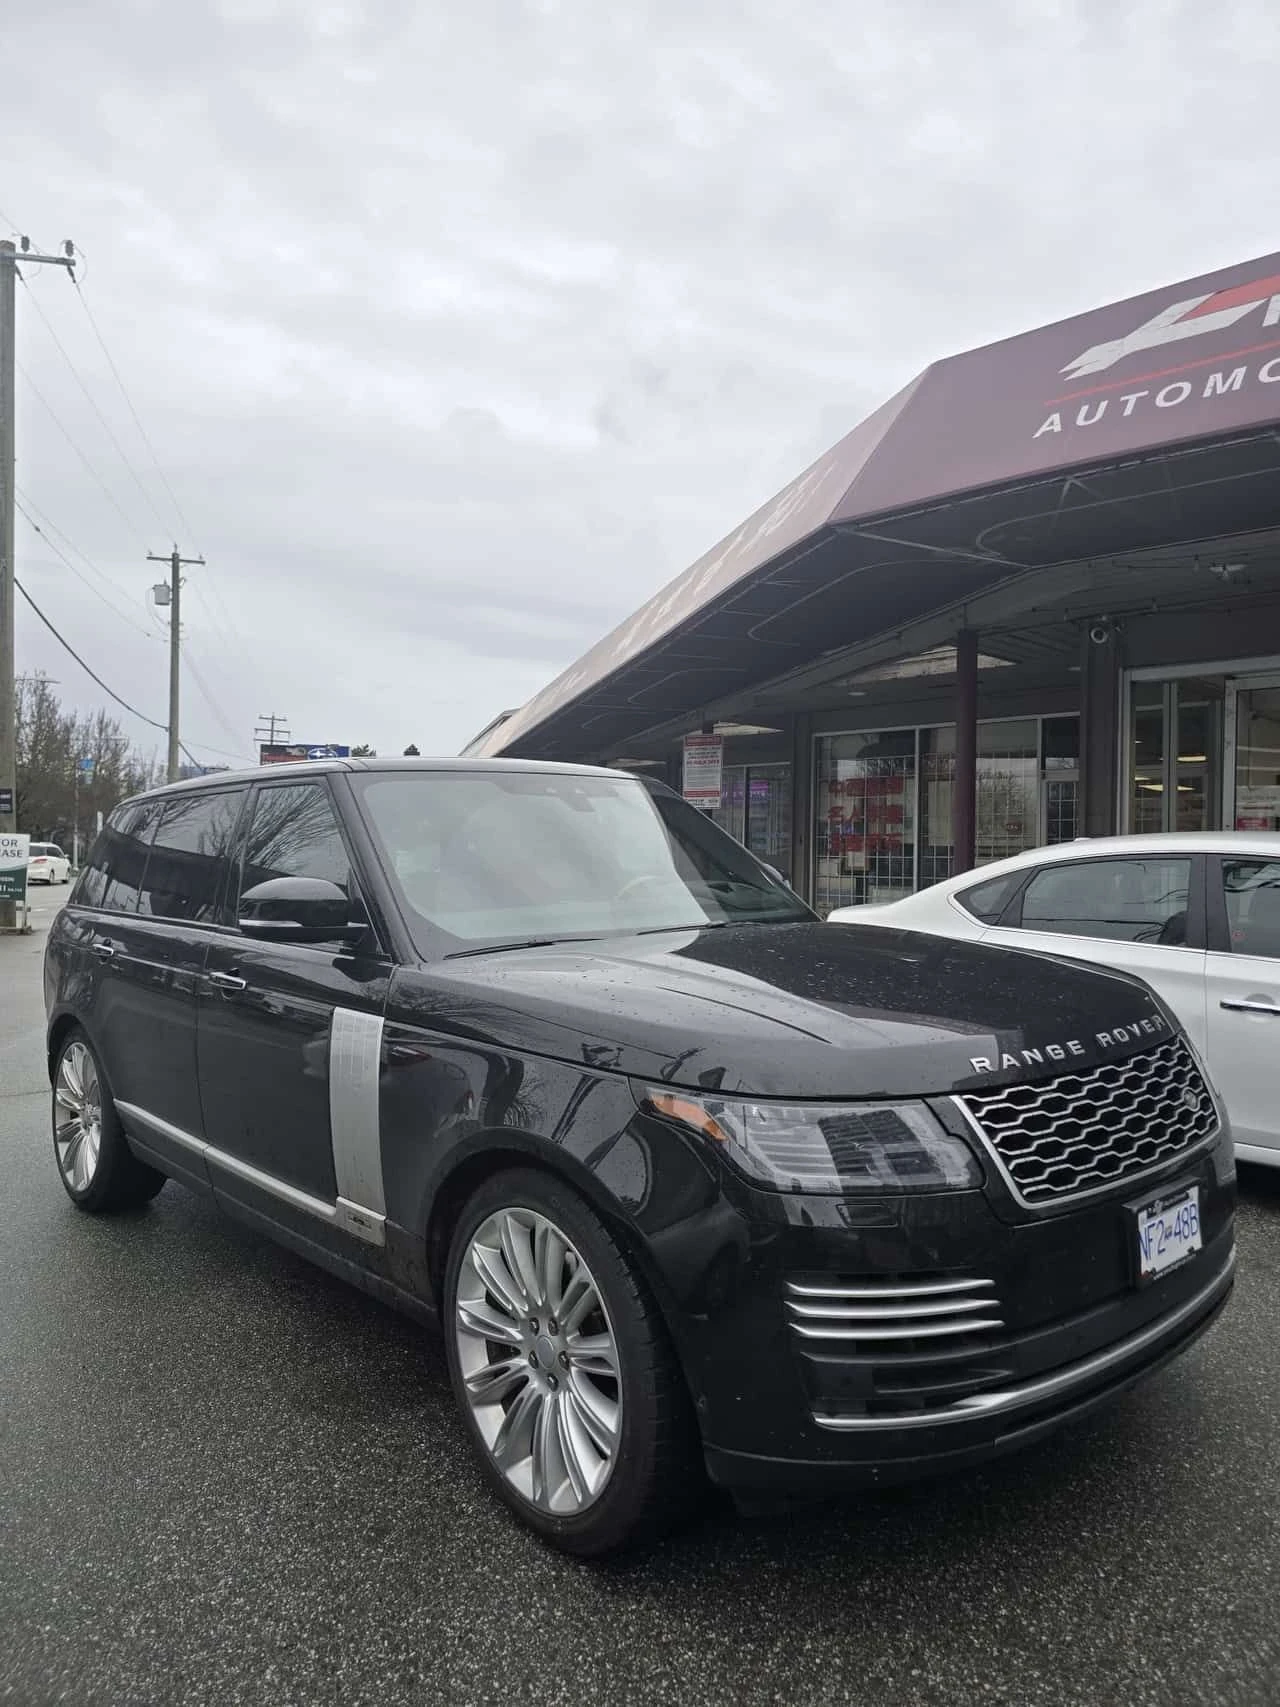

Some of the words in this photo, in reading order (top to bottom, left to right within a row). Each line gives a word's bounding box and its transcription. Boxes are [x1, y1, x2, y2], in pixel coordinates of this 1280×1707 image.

[0, 838, 18, 848] OR
[0, 849, 24, 858] ASE
[969, 1039, 1086, 1073] RANGE
[1095, 1014, 1166, 1048] ROVER
